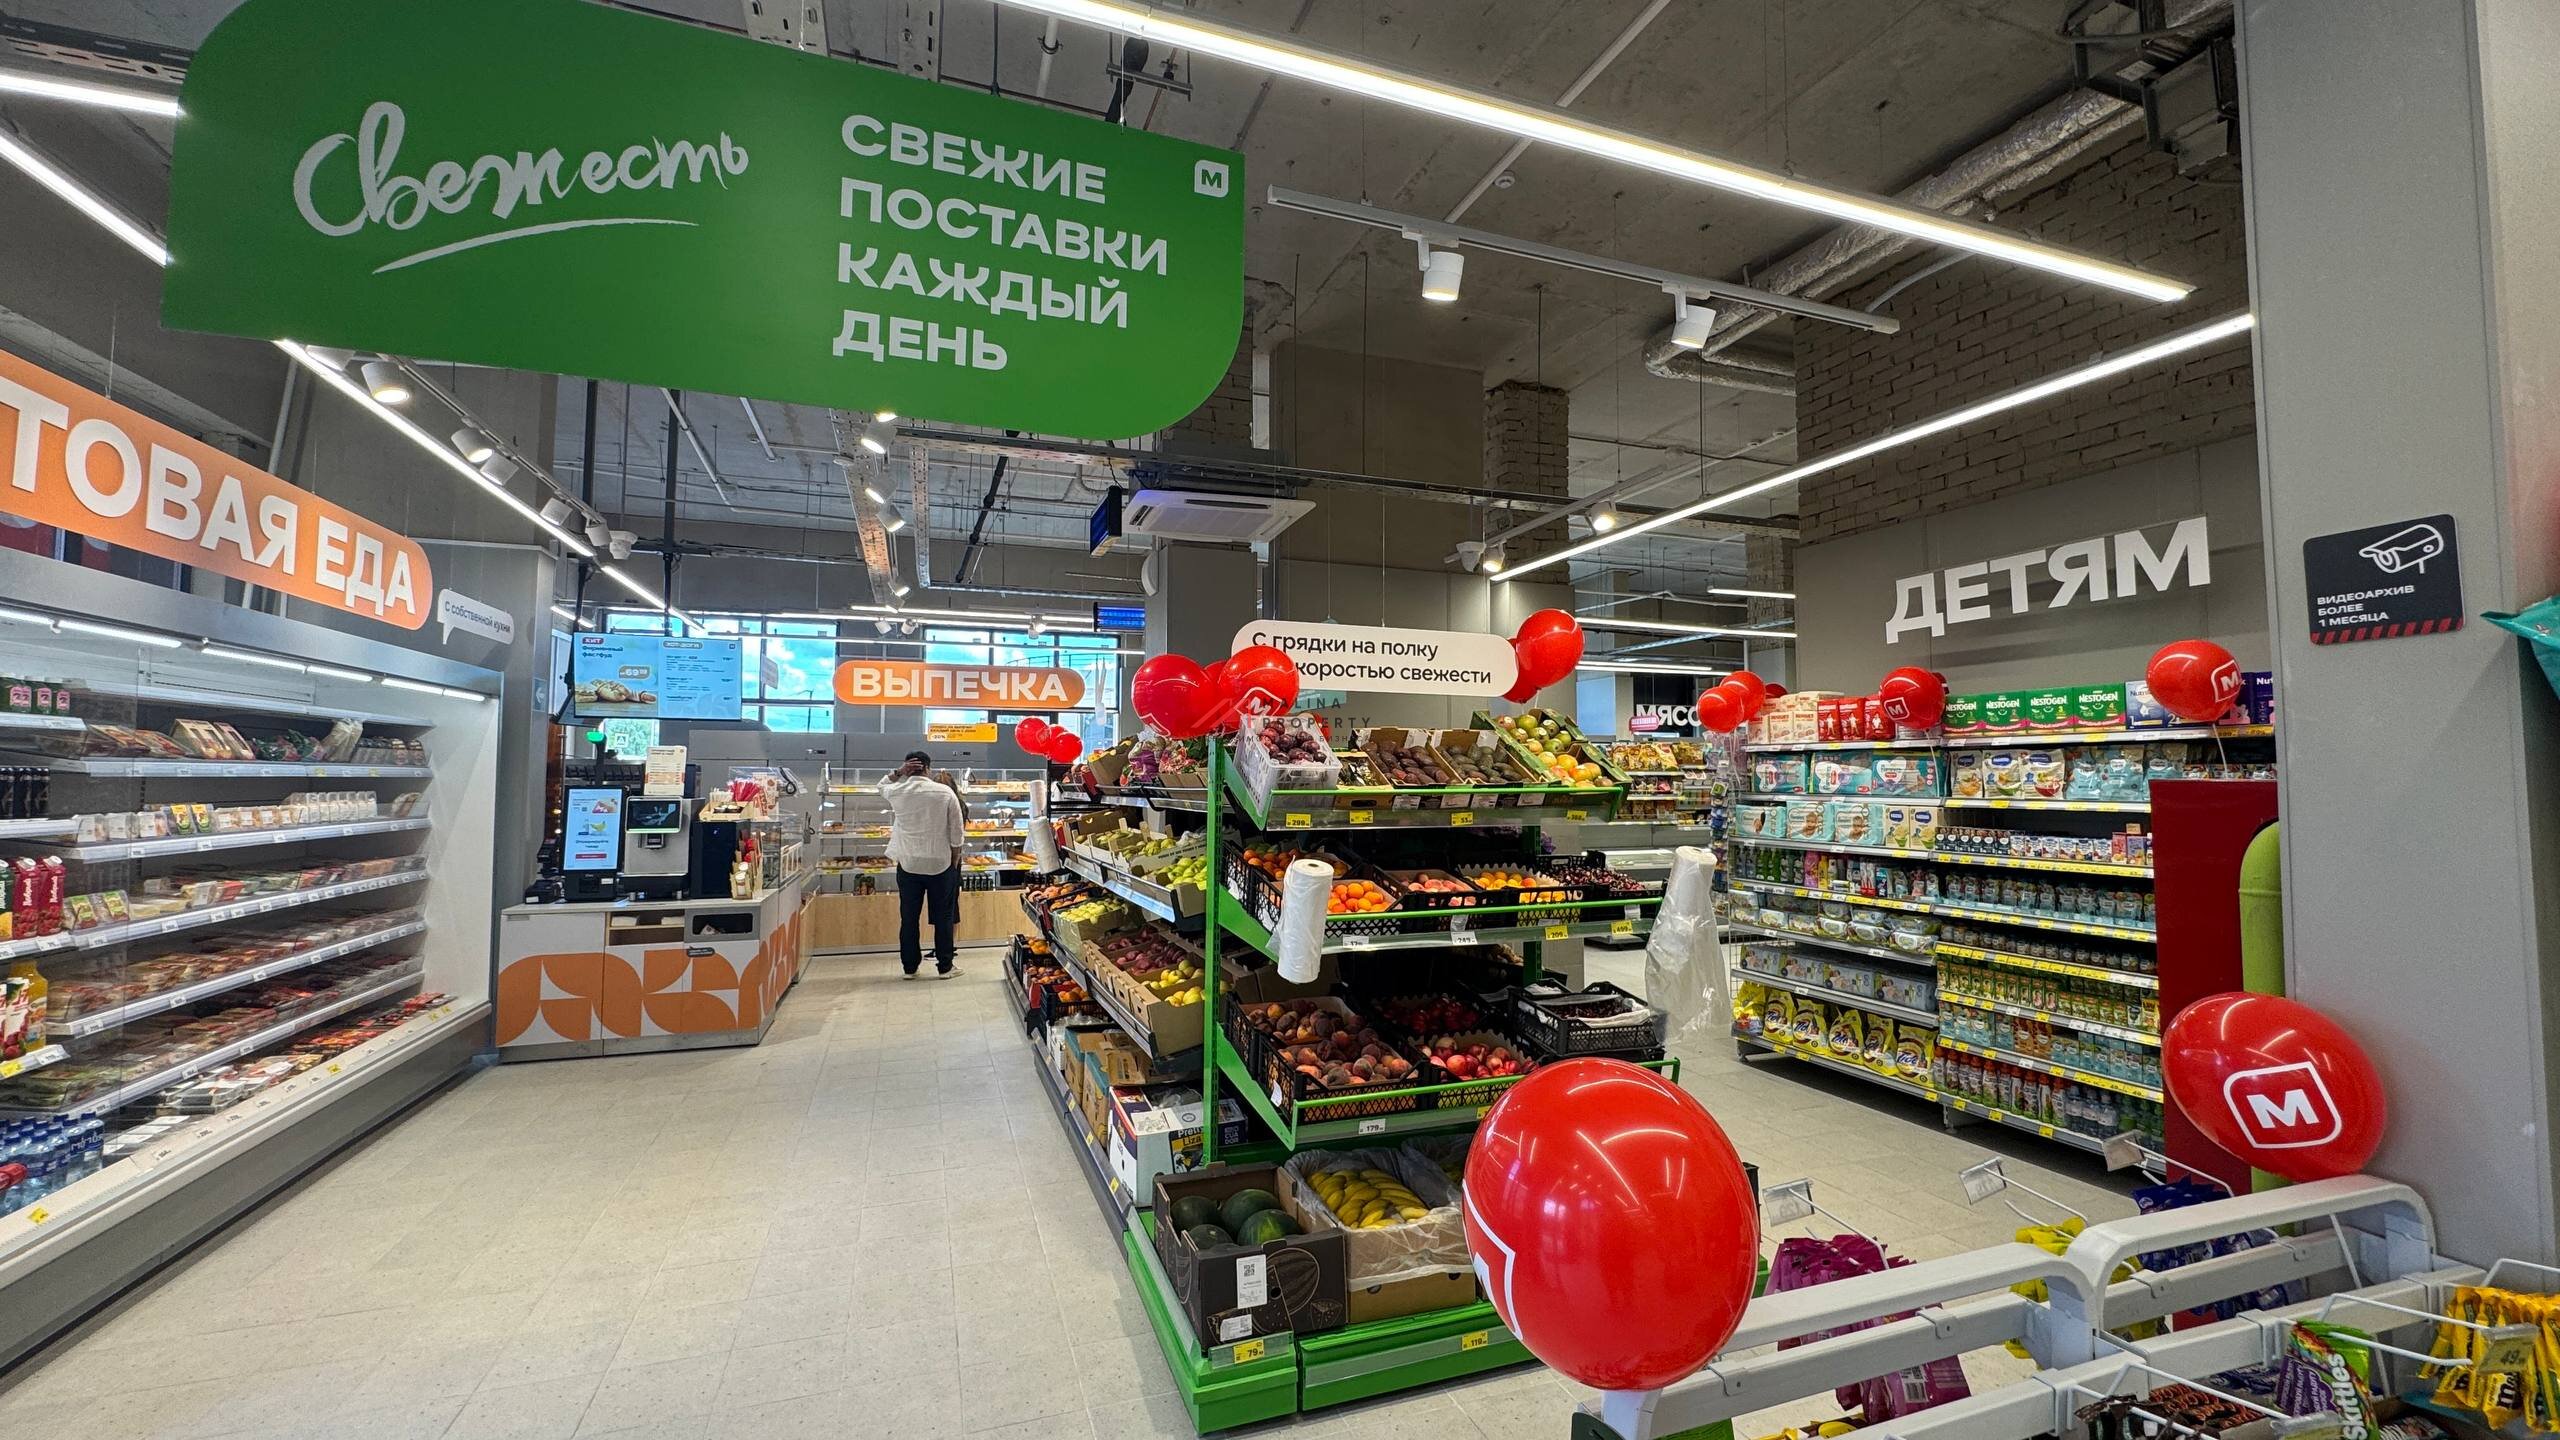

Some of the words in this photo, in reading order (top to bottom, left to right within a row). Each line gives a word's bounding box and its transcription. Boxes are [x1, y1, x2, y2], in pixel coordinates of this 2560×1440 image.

[293, 101, 749, 237] Свежесть
[841, 114, 1107, 205] СВЕЖИЕ
[840, 176, 1168, 276] ПОСТАВКИ
[837, 242, 1128, 329] КАЖДЫЙ
[832, 309, 1008, 372] ДЕНЬ
[315, 515, 417, 617] ЕДА
[1884, 515, 2211, 645] ДЕТЯМ
[2316, 585, 2415, 605] ВИДЕОАРХИВ
[451, 604, 493, 627] собственной
[2318, 603, 2364, 617] БОЛЕЕ
[2318, 618, 2326, 628] 1
[2329, 611, 2390, 627] МЕСЯЦА
[1273, 633, 1346, 654] грядки
[1352, 640, 1375, 654] на
[1382, 642, 1439, 661] полку
[1296, 661, 1395, 681] коростью
[1400, 665, 1492, 684] свежести
[852, 667, 1069, 702] ВЫПЕЧКА
[1985, 698, 2020, 709] NESTOGEN
[2031, 695, 2067, 706] NESTOGEN
[2078, 691, 2118, 703] NESTOGEN
[1636, 704, 1702, 727] МЯСО
[1896, 1050, 1918, 1065] Tide
[2246, 1088, 2320, 1130] М
[1366, 1124, 1380, 1132] 179
[1248, 1348, 1258, 1357] 79
[2501, 1349, 2520, 1364] 49
